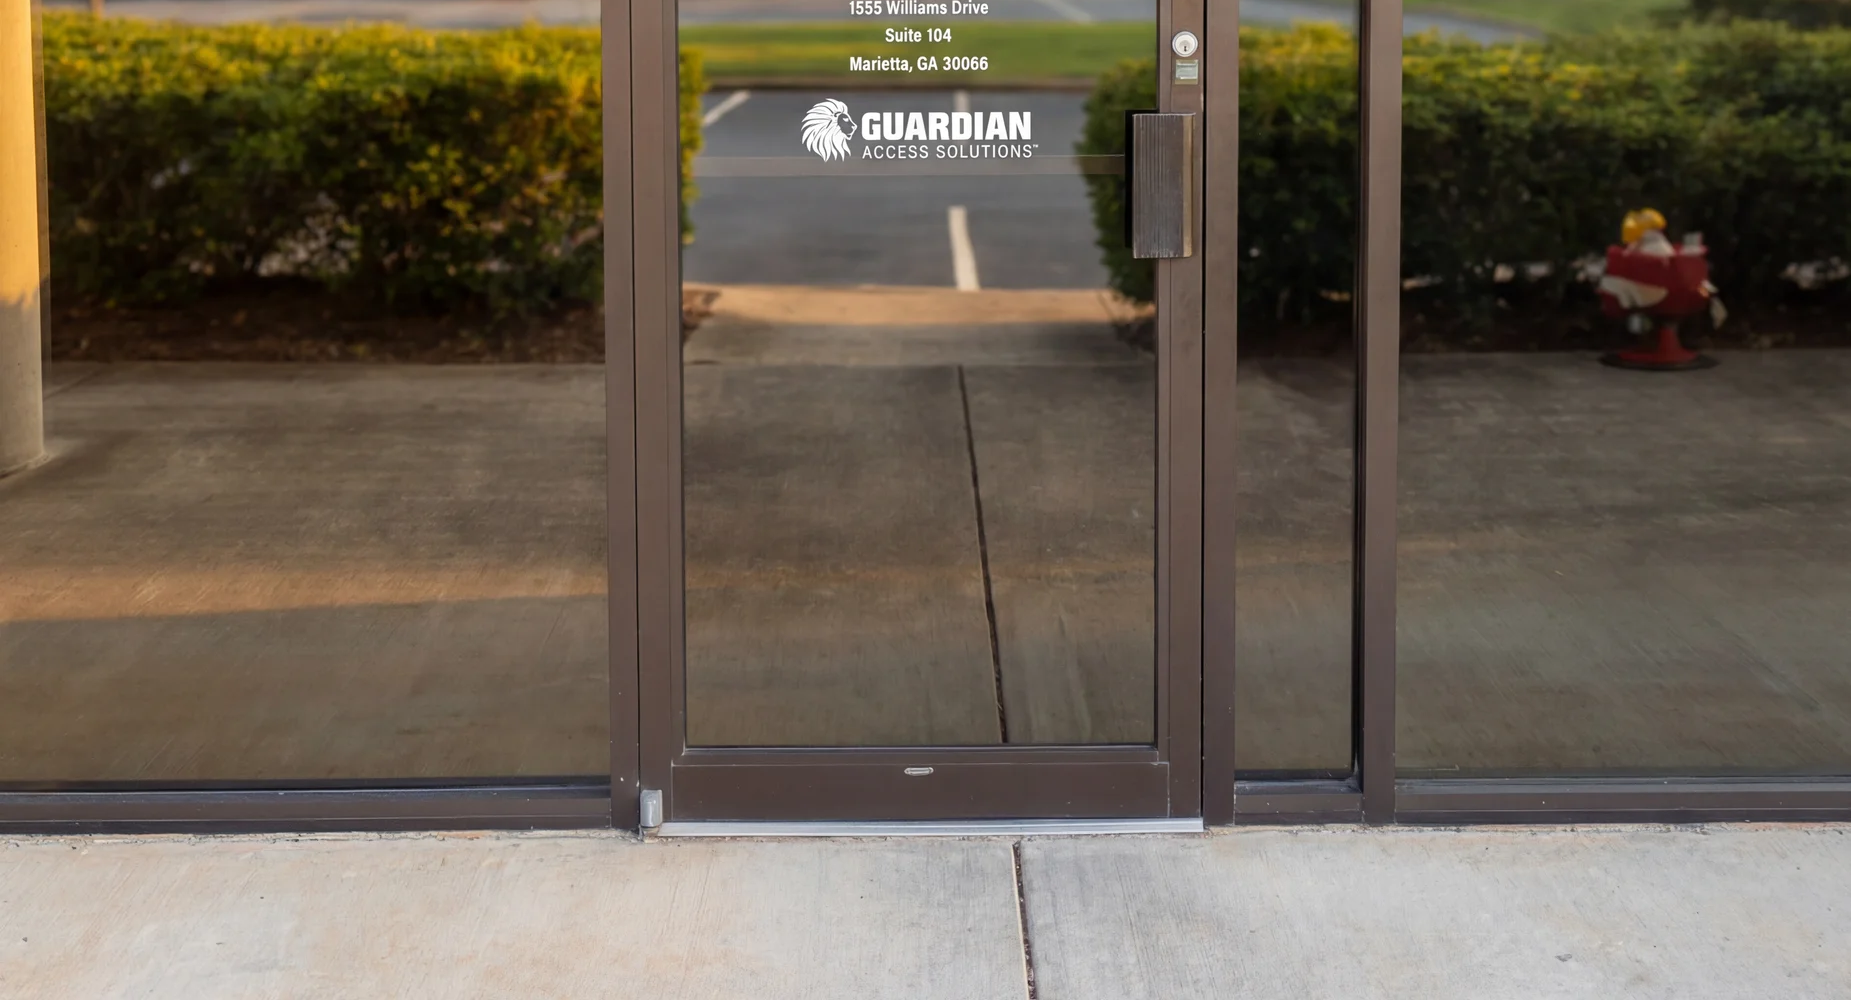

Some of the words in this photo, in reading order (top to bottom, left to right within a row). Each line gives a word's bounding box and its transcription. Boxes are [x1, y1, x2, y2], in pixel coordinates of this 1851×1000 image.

[849, 0, 883, 15] 1555
[885, 0, 948, 15] Williams
[951, 0, 989, 15] Drive
[885, 27, 922, 43] Suite
[927, 28, 952, 43] 104
[850, 55, 913, 73] Marietta,
[917, 56, 938, 71] GA
[942, 56, 989, 71] 30066
[861, 111, 1032, 141] GUARDIAN
[861, 144, 929, 160] ACCESS
